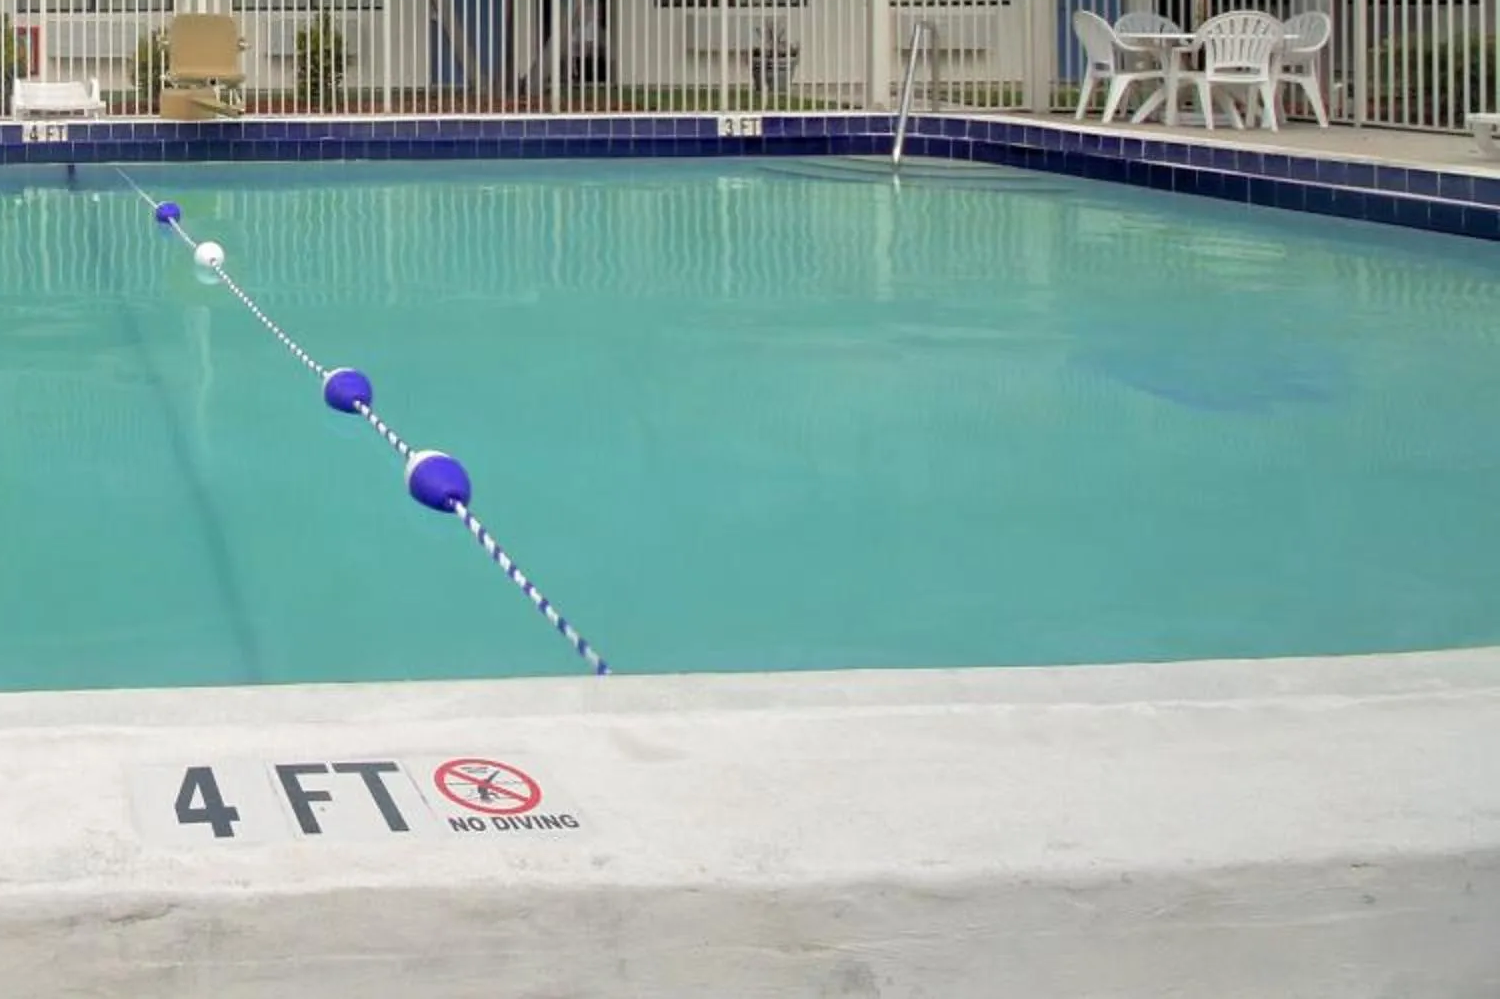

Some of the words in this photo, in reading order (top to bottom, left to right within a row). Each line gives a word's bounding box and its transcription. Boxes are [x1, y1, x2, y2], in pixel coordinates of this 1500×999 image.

[29, 124, 39, 142] 4
[45, 124, 65, 141] FT
[740, 117, 761, 137] FT
[174, 766, 241, 838] 4
[275, 761, 410, 835] FT
[449, 816, 486, 832] NO
[490, 814, 580, 832] DIVING
